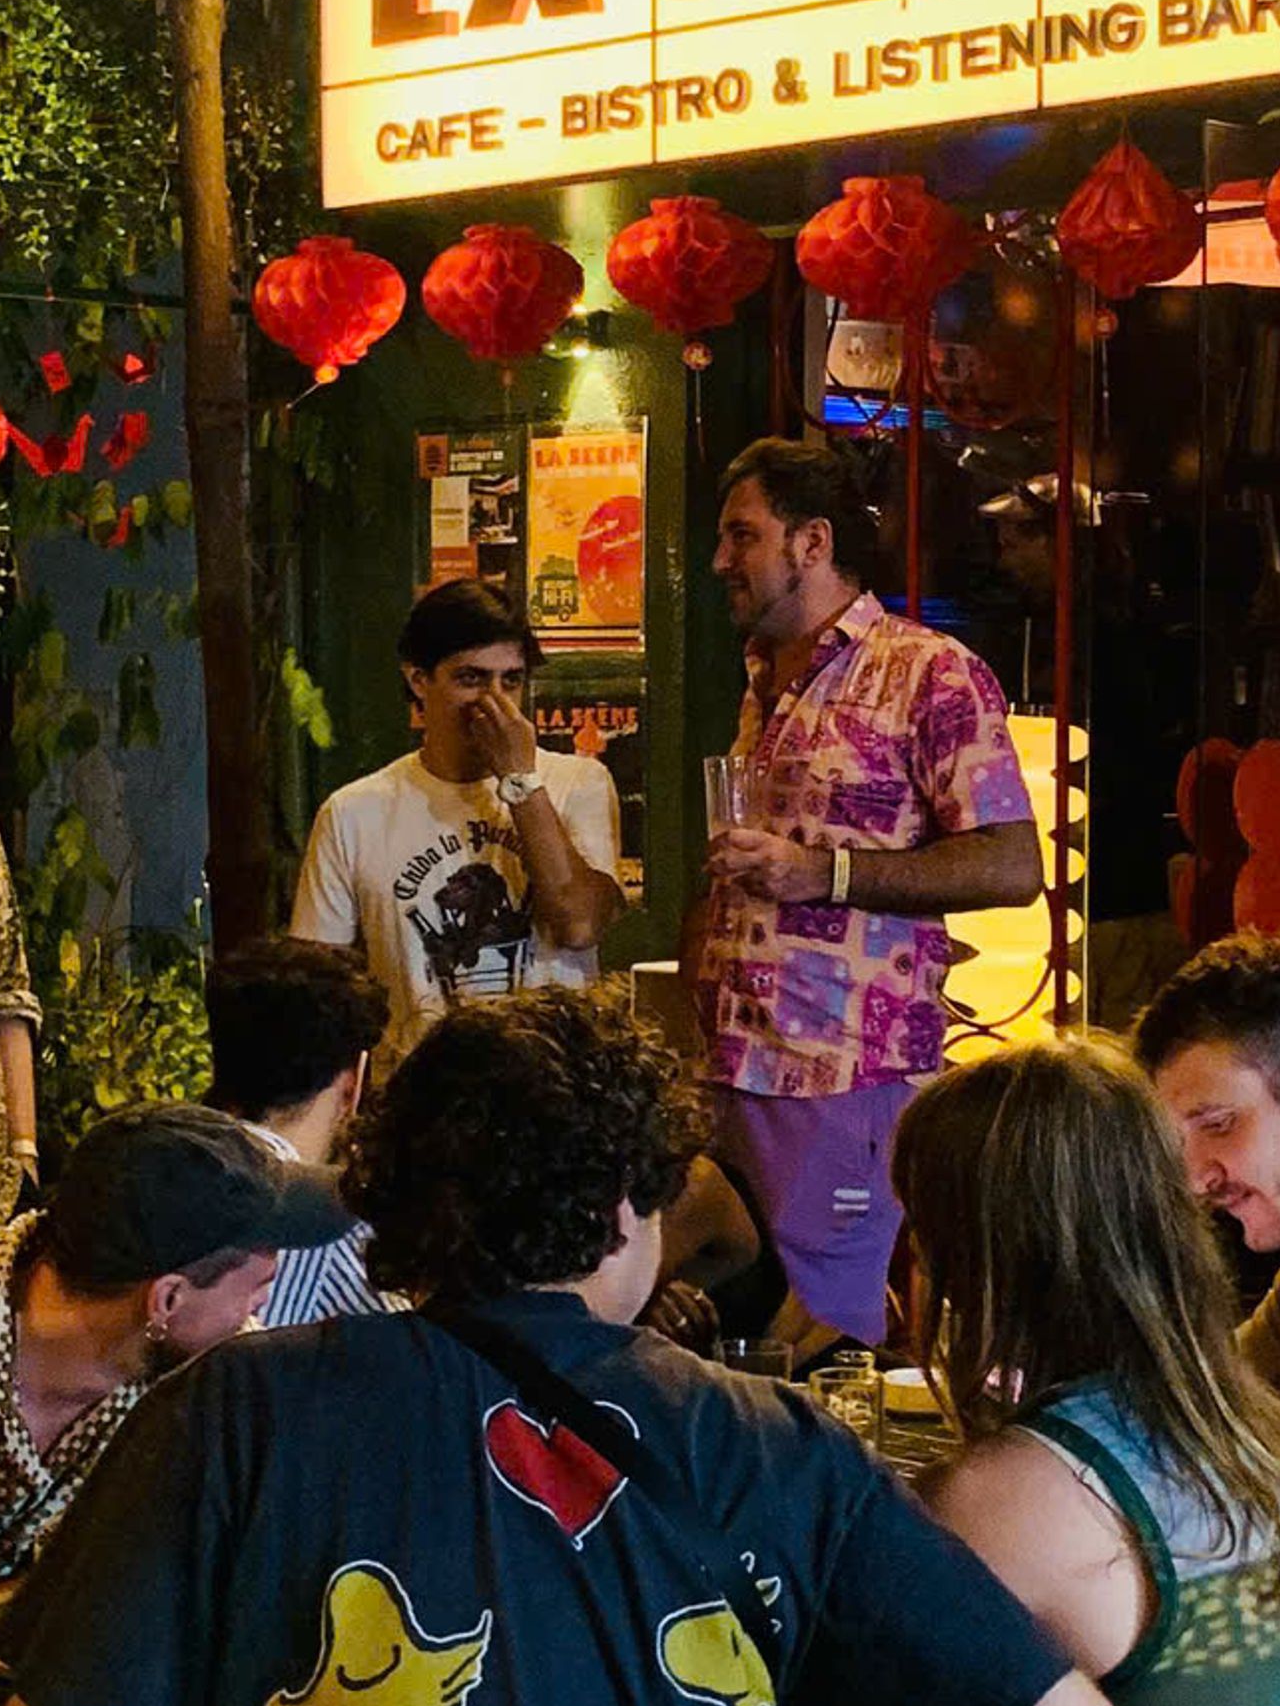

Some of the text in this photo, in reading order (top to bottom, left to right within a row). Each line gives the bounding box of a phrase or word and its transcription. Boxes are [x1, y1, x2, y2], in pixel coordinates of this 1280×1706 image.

[376, 105, 506, 165] CAFE
[560, 62, 749, 143] BISTRO
[773, 56, 808, 104] &
[833, 0, 1146, 99] LISTENING
